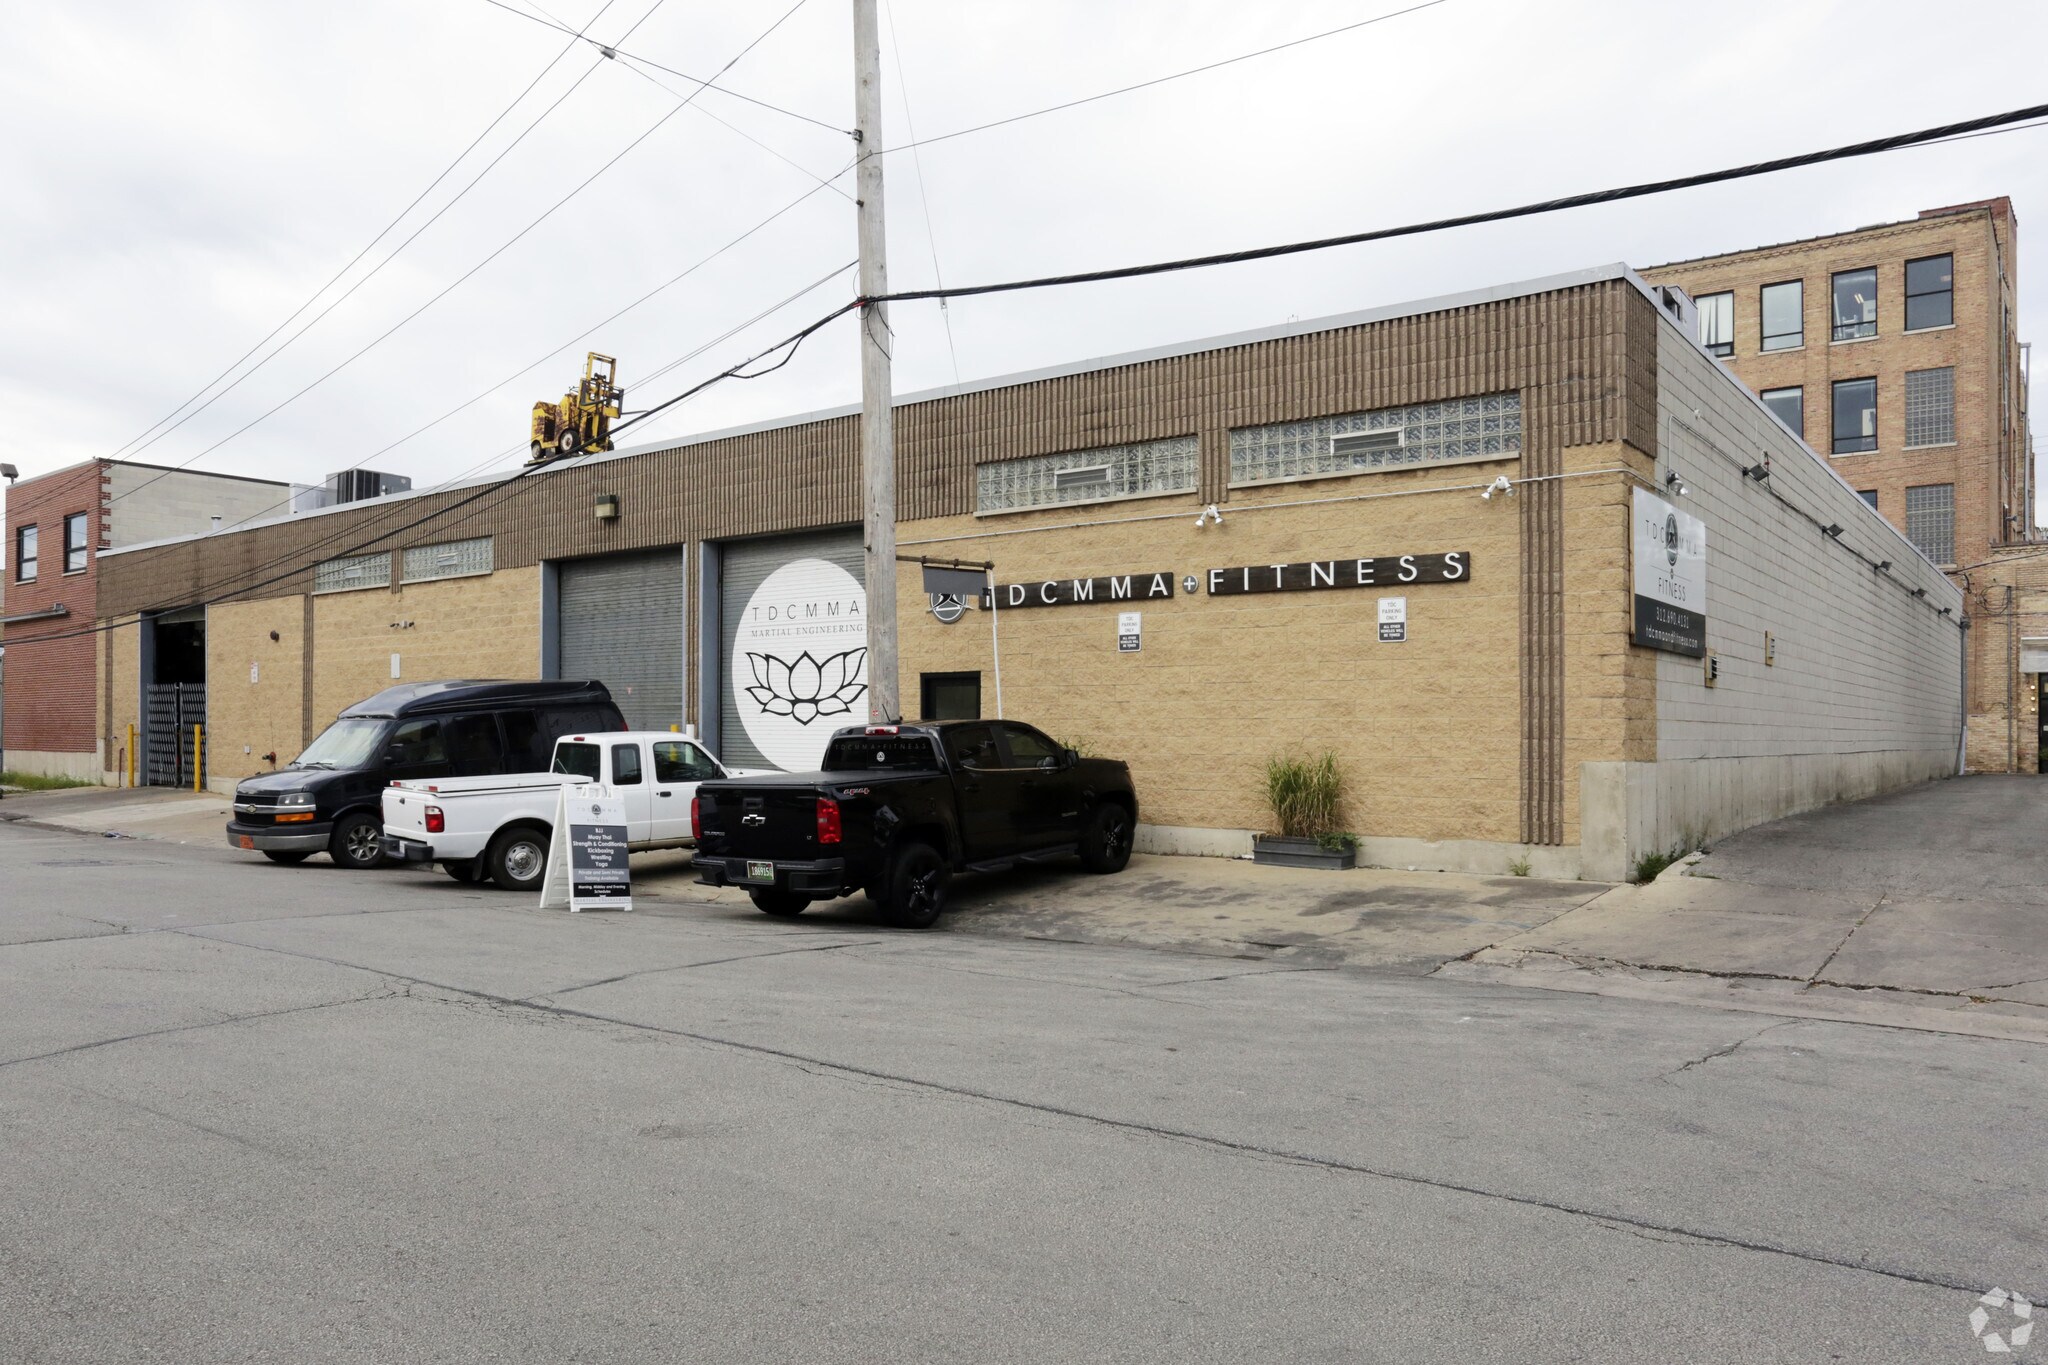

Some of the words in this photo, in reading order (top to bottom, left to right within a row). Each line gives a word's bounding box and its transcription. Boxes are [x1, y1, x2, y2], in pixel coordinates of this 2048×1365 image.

[1210, 552, 1464, 593] FITNESS
[1658, 577, 1686, 601] FITNESS
[752, 600, 860, 621] TDCMMA
[751, 628, 792, 638] MARTIAL
[796, 623, 864, 635] ENGINEERING
